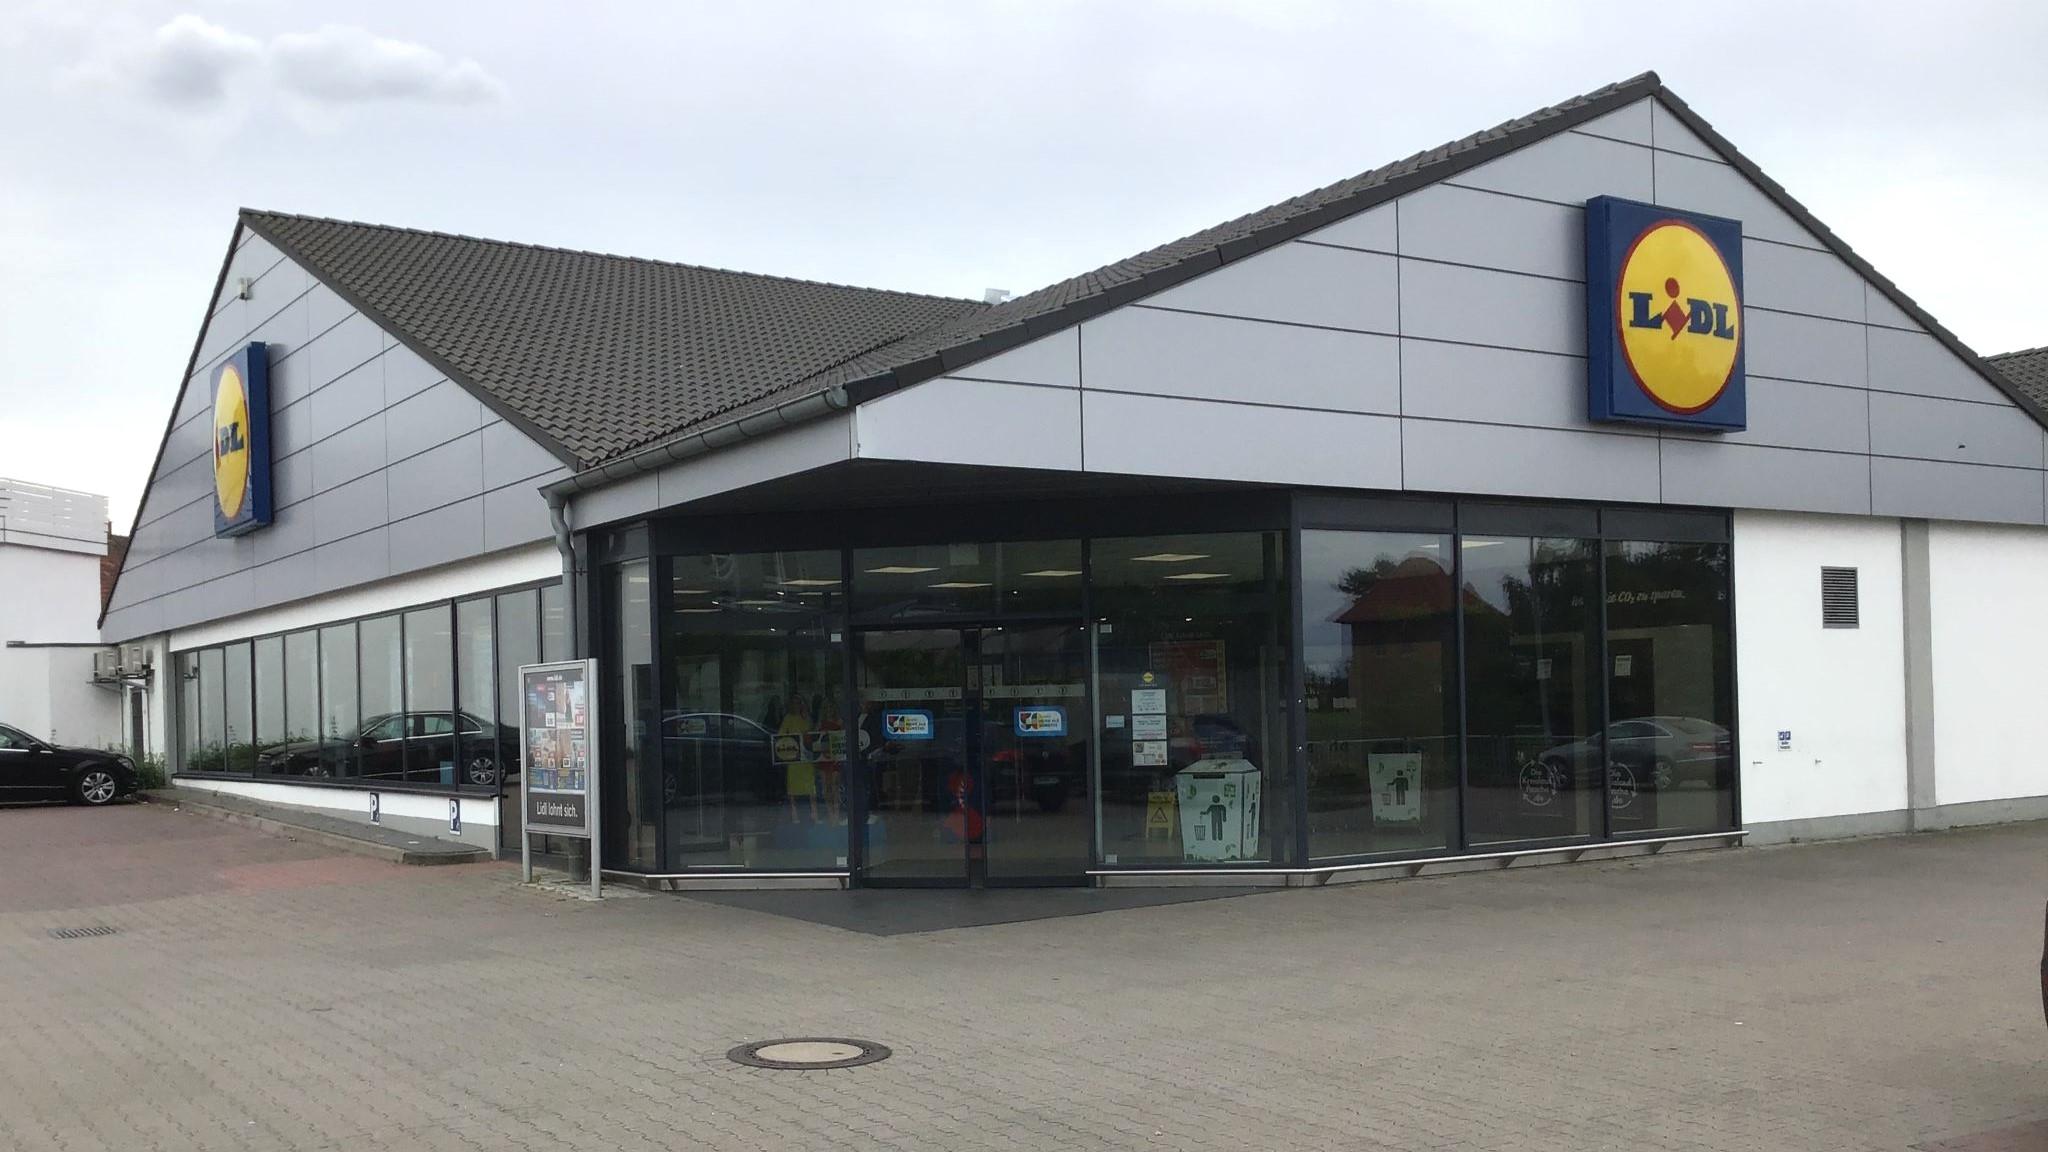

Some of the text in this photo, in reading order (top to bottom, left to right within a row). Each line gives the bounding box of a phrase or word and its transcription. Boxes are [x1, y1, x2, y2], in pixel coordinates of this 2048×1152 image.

[536, 801, 578, 818] Lidl lohnt sich.
